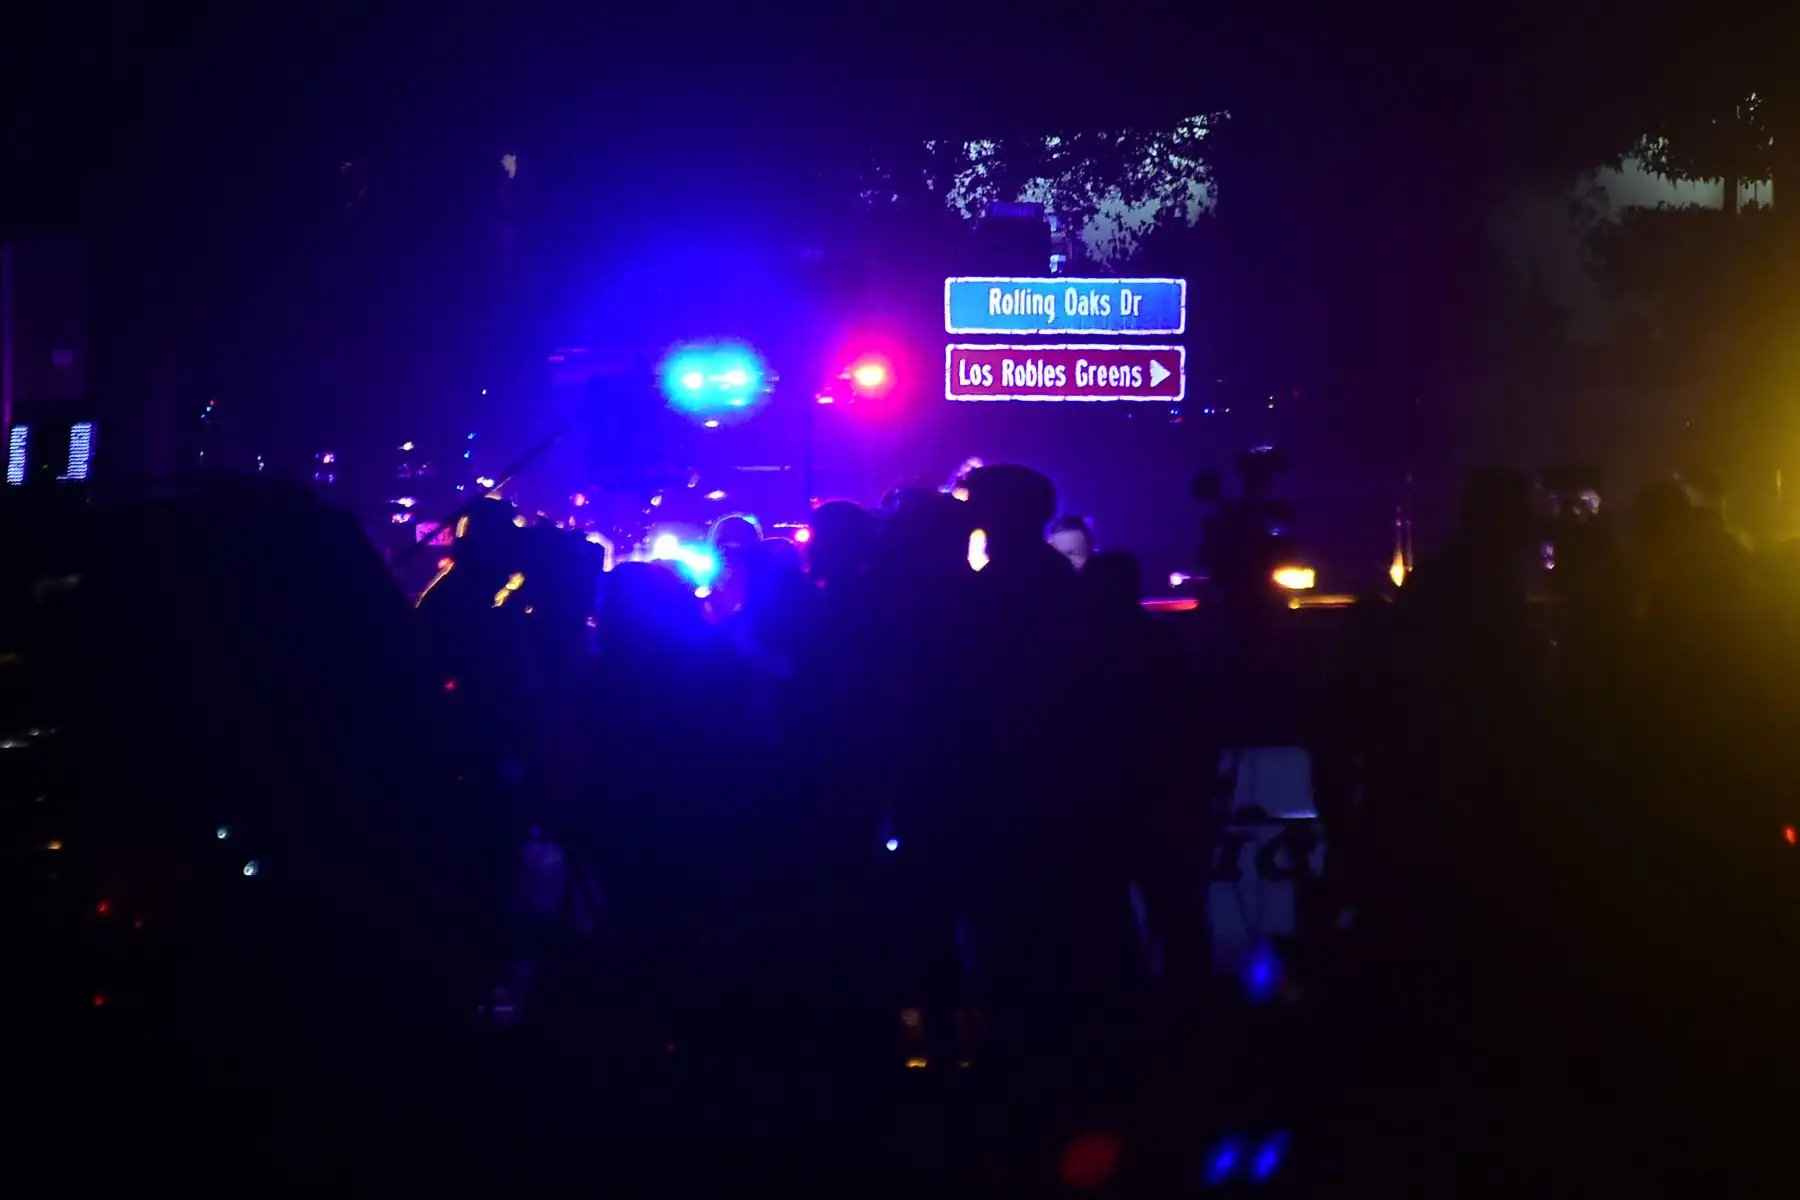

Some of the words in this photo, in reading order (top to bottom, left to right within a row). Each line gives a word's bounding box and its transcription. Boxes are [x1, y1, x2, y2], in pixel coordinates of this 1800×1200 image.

[988, 287, 1056, 324] Rolling
[1064, 287, 1112, 317] Oaks
[1120, 289, 1143, 317] Dr
[958, 358, 994, 388] Los
[1001, 359, 1067, 388] Robles
[1075, 359, 1143, 388] Greens
